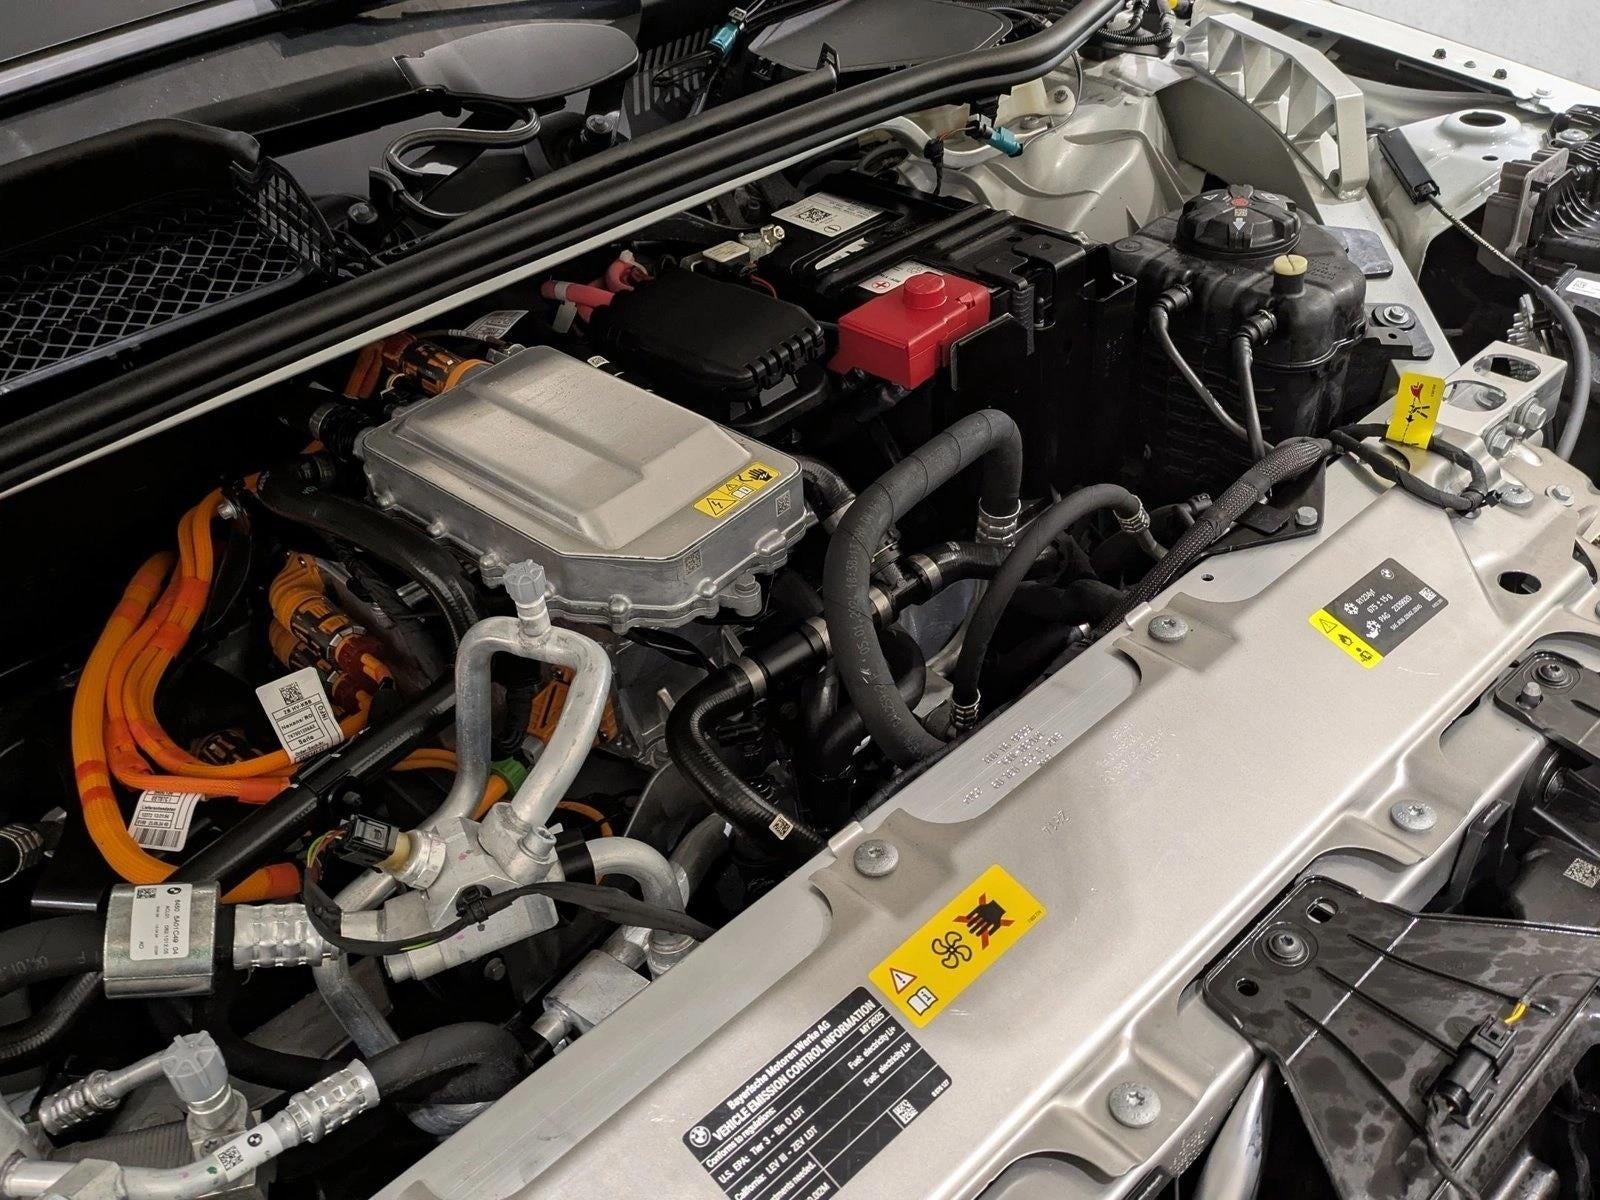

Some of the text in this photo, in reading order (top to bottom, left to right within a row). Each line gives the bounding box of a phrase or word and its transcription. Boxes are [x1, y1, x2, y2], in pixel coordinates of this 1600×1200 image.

[1367, 604, 1378, 613] 675
[1380, 595, 1389, 603] 15
[1378, 612, 1391, 623] PAG
[317, 705, 329, 721] INFO
[298, 735, 314, 745] Serie
[172, 946, 179, 955] 04
[859, 1011, 885, 1035] MY 2025
[726, 1020, 831, 1110] Bayerische Motoren Werke AG
[847, 1056, 865, 1070] Fuel:
[862, 1031, 890, 1058] electricity
[712, 999, 876, 1141] VEHICLE EMISSION CONTROL INFORMATION
[862, 1071, 880, 1087] Fuel:
[878, 1047, 905, 1075] electricity
[705, 1107, 777, 1168] Conforms to regulations:
[718, 1170, 735, 1184] U.S.
[732, 1156, 751, 1172] EPA:
[750, 1142, 765, 1156] Tier
[762, 1136, 771, 1146] 3
[773, 1122, 788, 1136] Bin
[784, 1117, 793, 1126] 0
[791, 1105, 806, 1119] LDT
[734, 1173, 767, 1200] California:
[765, 1159, 781, 1175] LEV
[778, 1152, 788, 1163] III
[790, 1139, 806, 1153] ZEV
[804, 1125, 818, 1141] LDT
[792, 1161, 816, 1184] needed.
